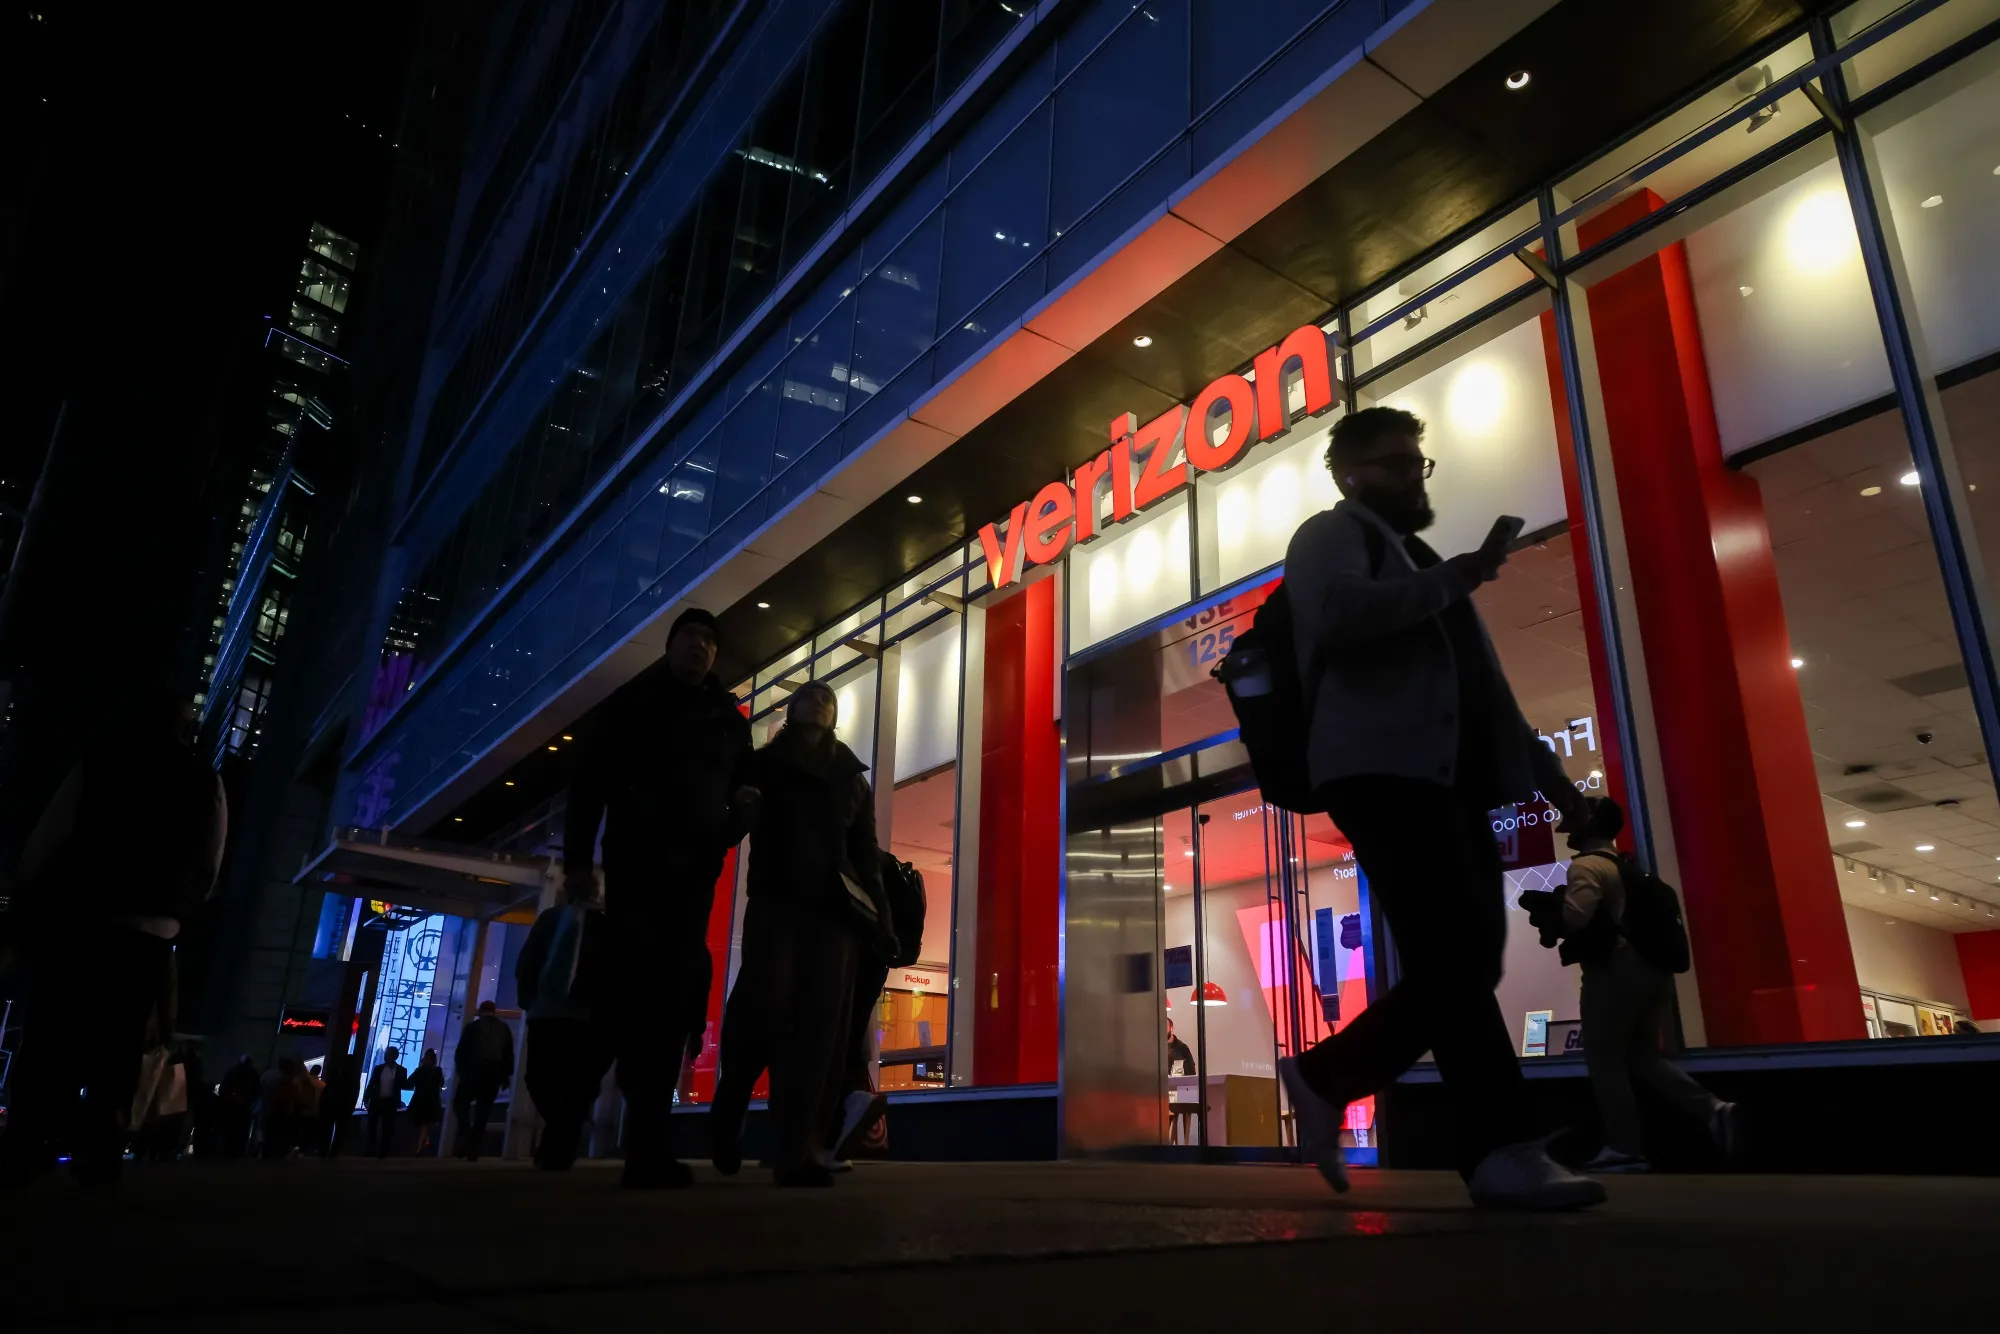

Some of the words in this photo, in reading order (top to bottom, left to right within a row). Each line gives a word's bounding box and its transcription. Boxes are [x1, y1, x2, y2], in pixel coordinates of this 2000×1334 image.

[978, 324, 1338, 590] verizon
[1187, 624, 1235, 667] 125
[904, 974, 930, 986] Pickup
